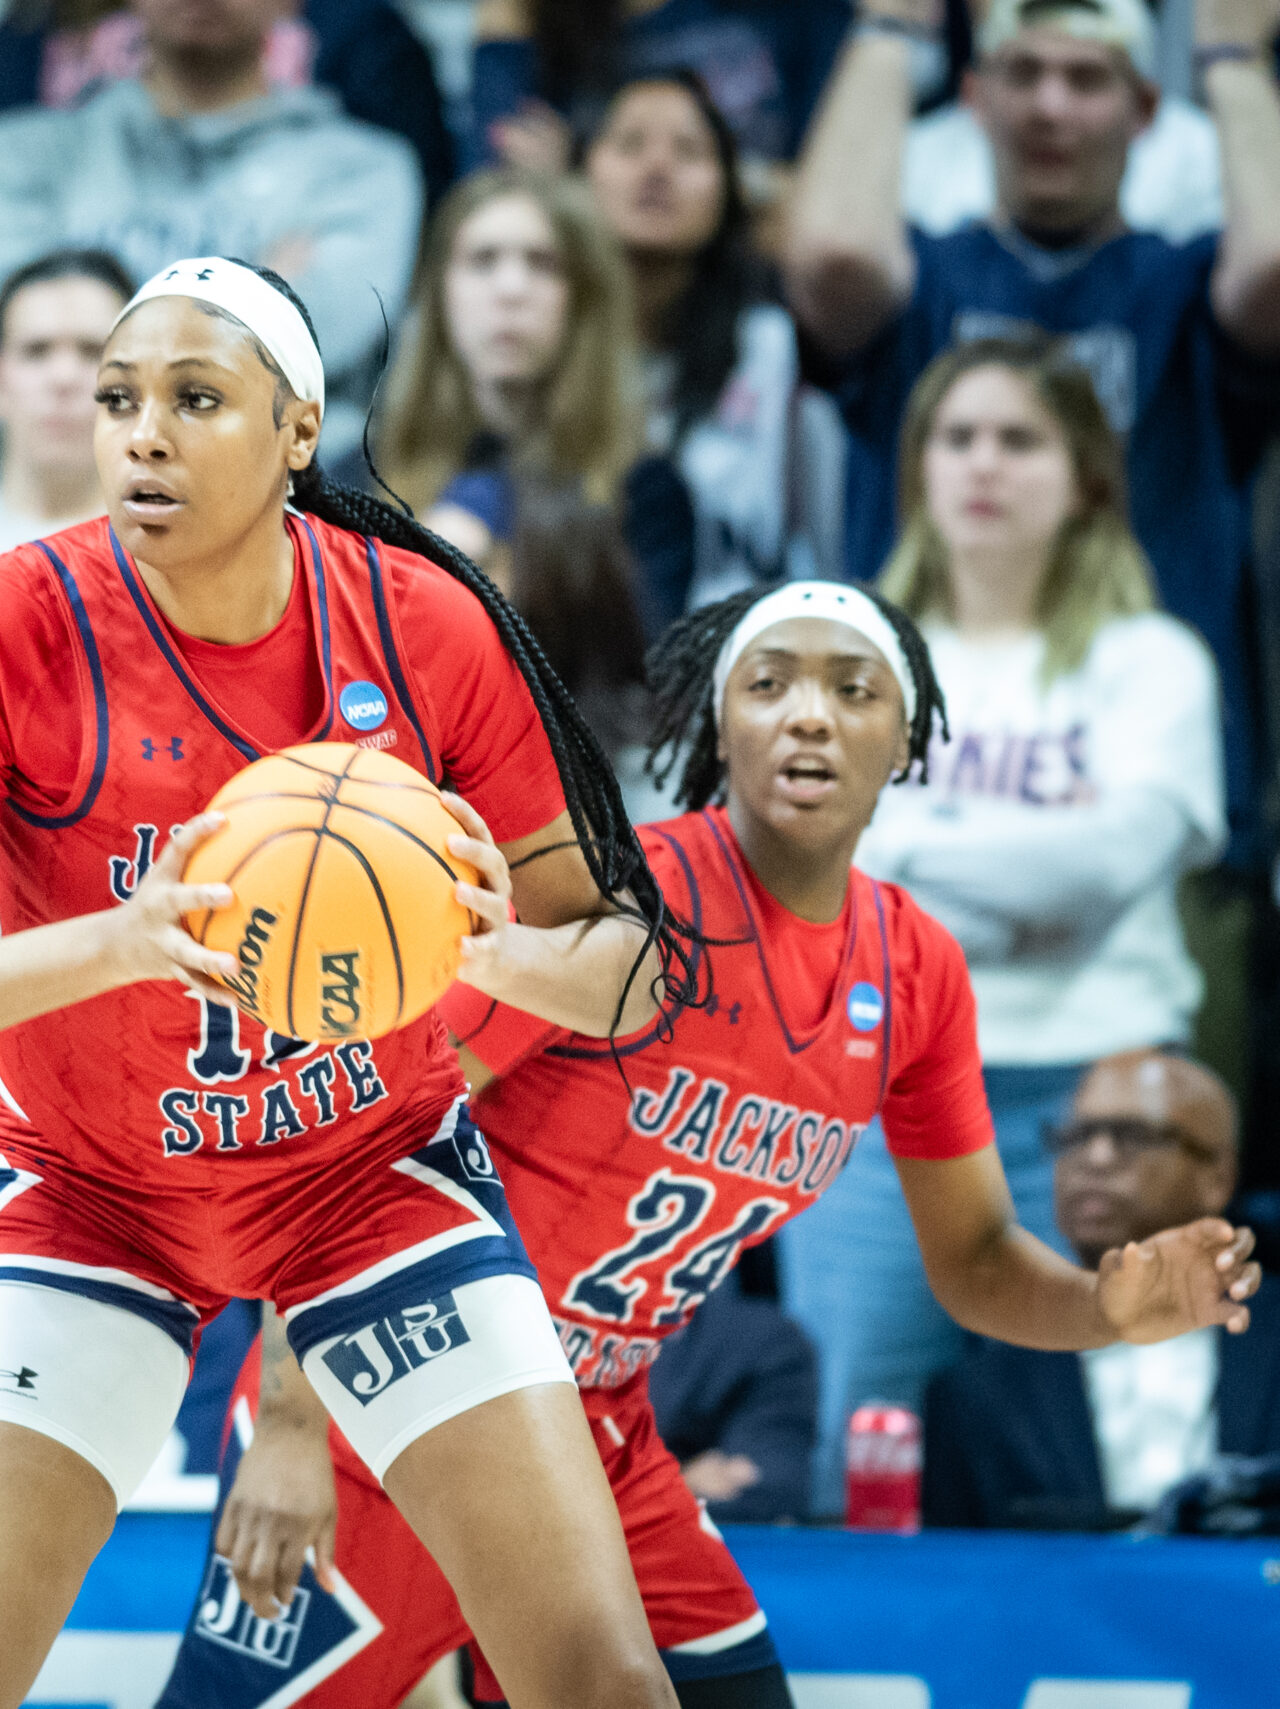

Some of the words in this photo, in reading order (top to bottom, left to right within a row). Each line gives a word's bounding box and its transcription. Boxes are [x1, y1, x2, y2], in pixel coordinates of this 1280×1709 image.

[347, 701, 386, 720] NCAA
[184, 988, 320, 1085] 1
[321, 951, 360, 1038] CAA
[159, 1039, 390, 1158] STATE
[560, 1166, 789, 1328] 24
